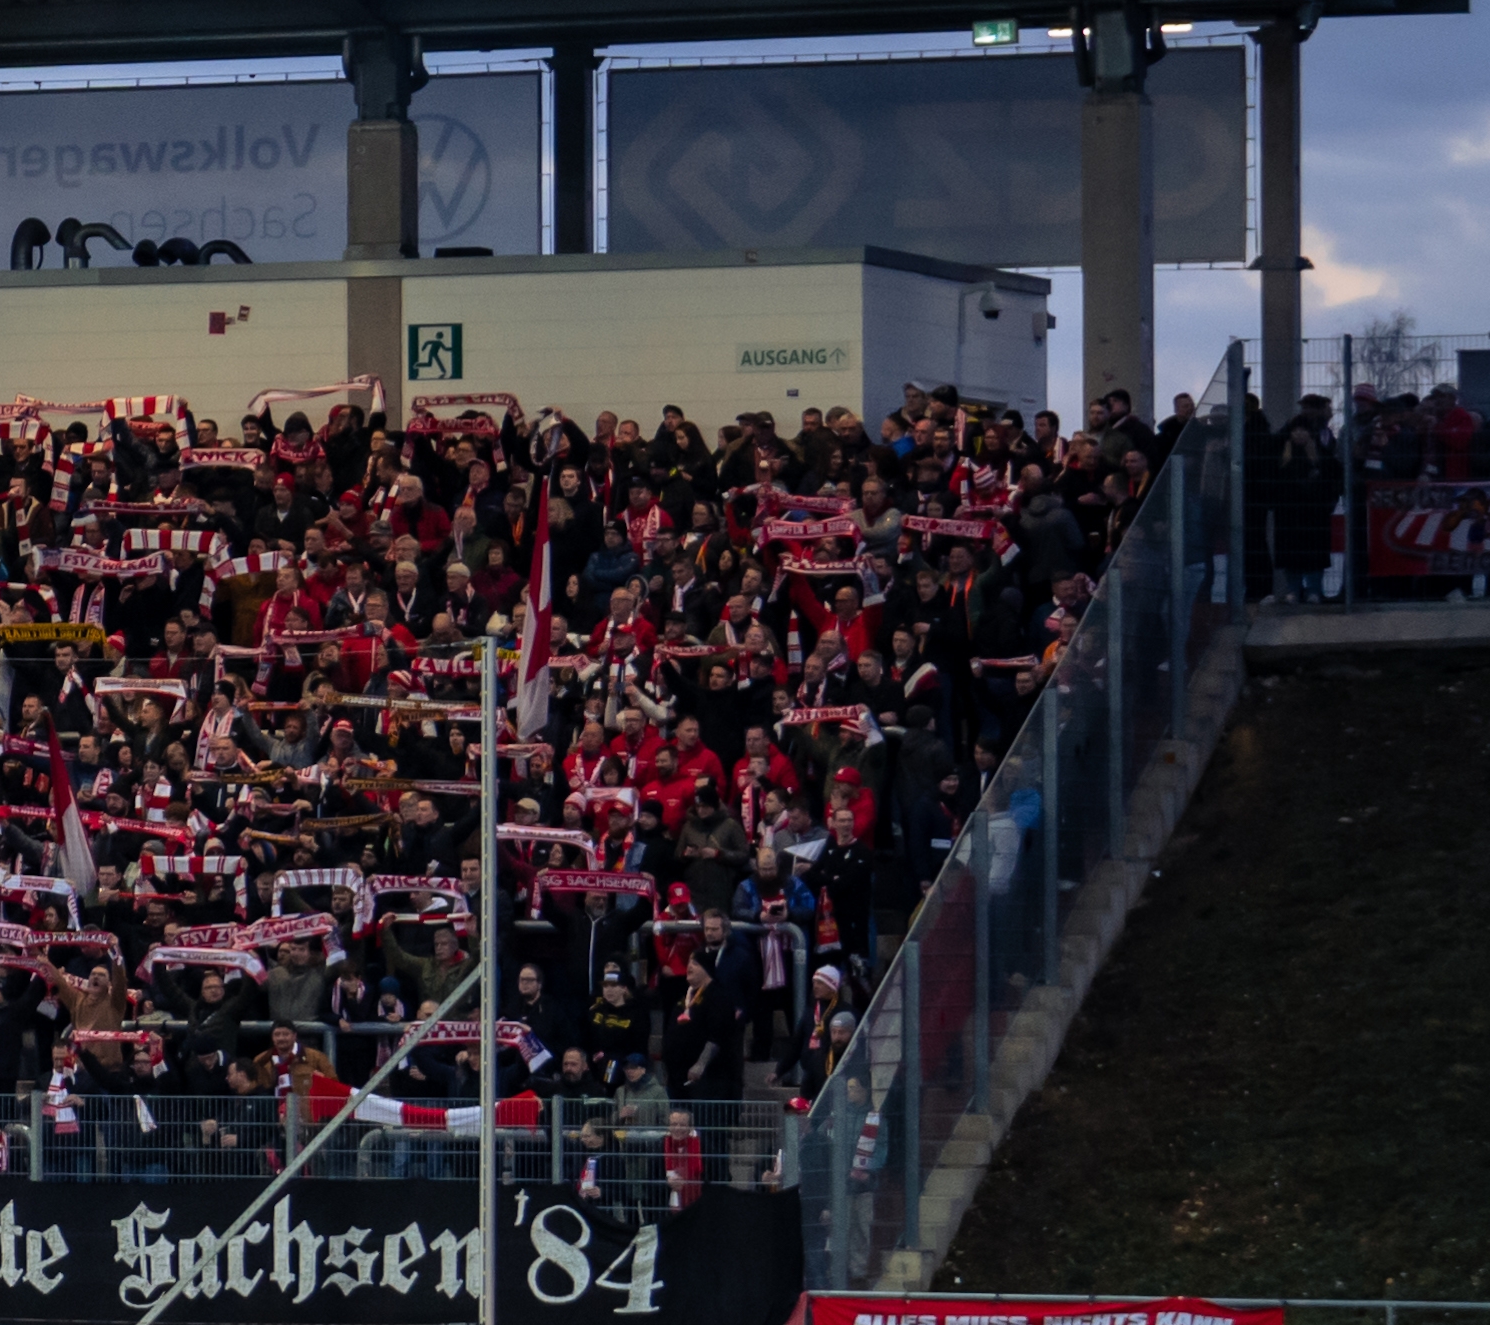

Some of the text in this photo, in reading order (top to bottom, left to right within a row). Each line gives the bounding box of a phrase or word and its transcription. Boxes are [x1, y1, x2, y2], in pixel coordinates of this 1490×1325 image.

[740, 347, 827, 368] AUSGANG
[64, 554, 90, 567] FSV
[110, 1192, 482, 1311] Sachsen
